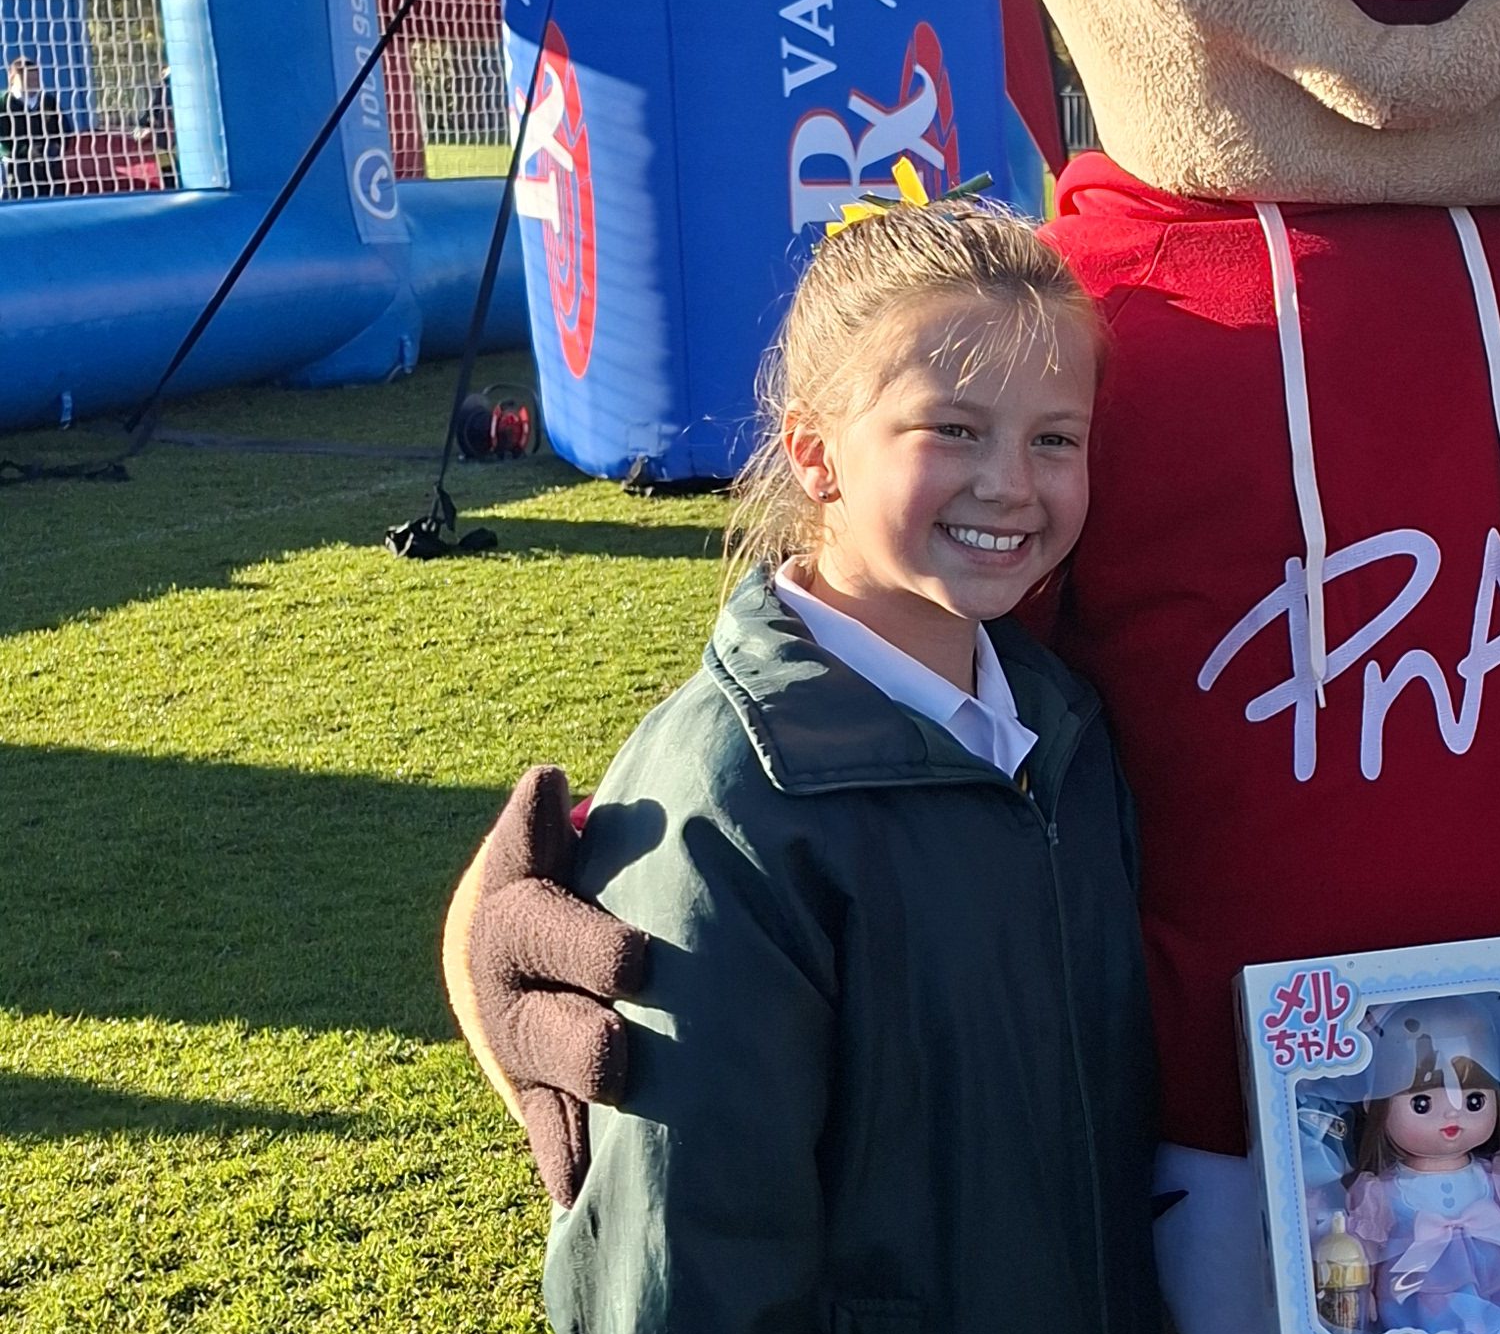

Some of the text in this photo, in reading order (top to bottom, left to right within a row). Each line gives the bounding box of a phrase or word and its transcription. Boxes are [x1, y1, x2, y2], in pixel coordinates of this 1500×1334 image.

[1265, 971, 1351, 1028] メル
[1266, 1023, 1356, 1066] ちゃん
